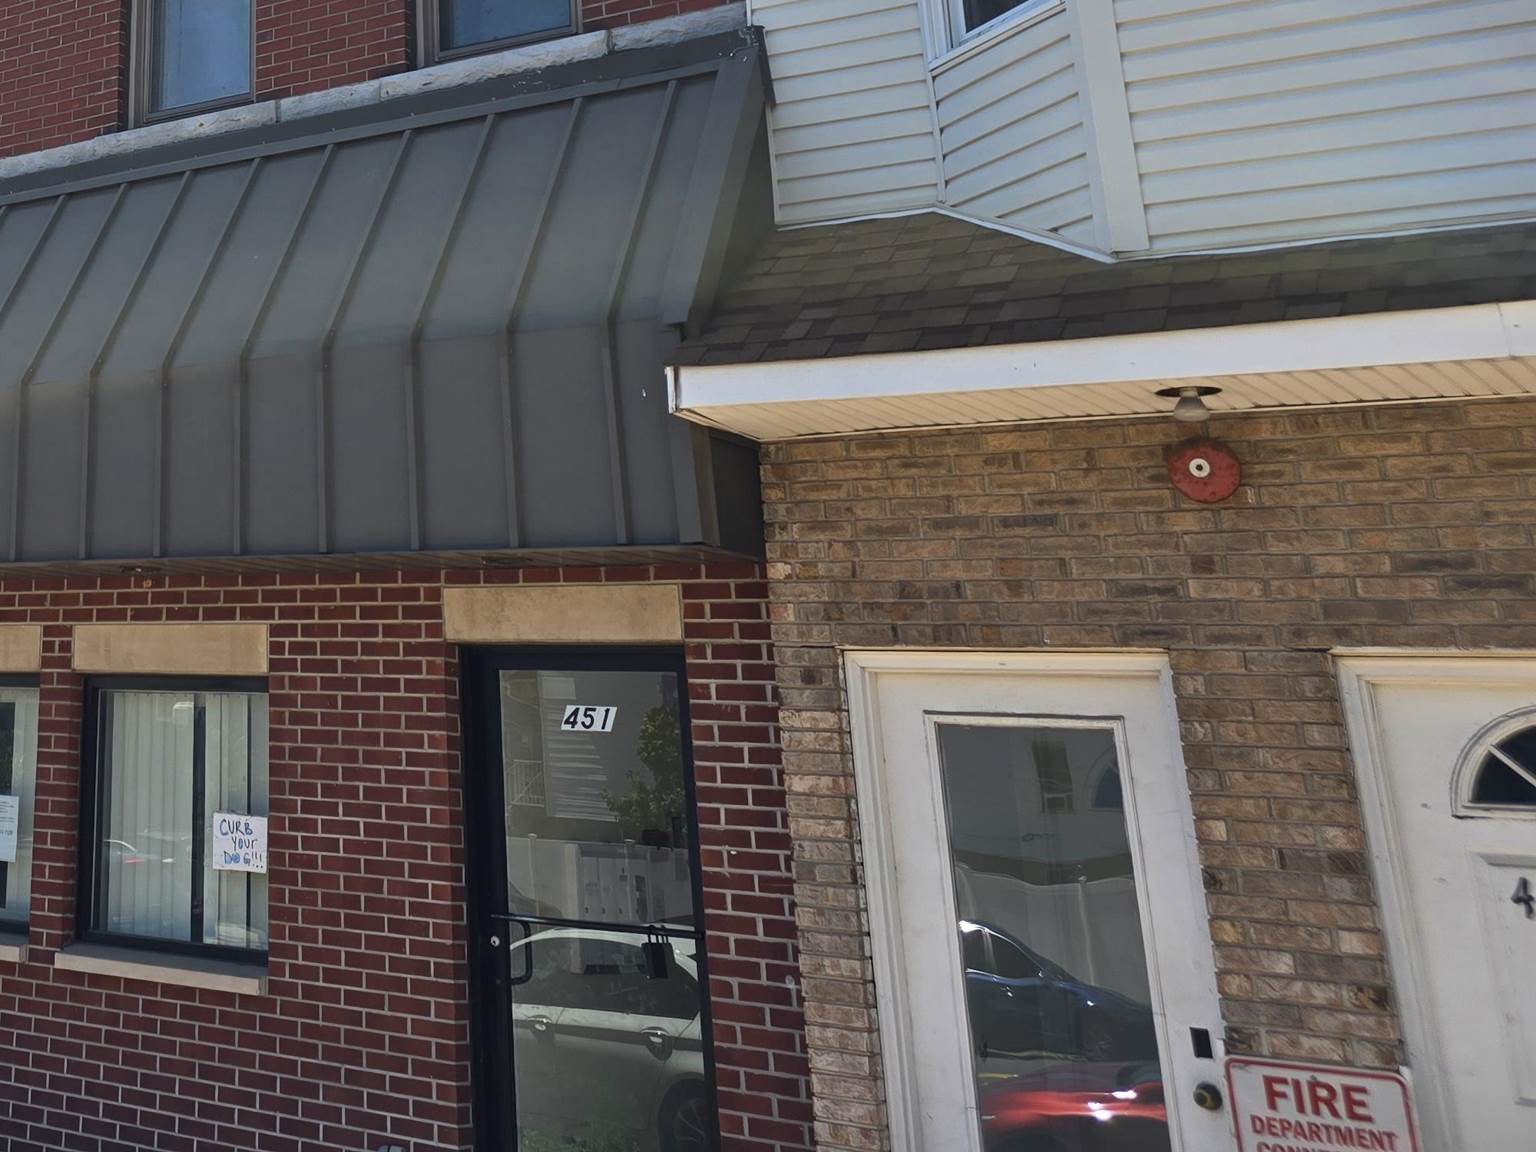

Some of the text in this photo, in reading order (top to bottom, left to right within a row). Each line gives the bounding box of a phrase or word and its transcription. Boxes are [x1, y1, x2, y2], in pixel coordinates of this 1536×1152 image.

[564, 707, 611, 730] 451
[219, 818, 253, 836] CURB
[1262, 1073, 1376, 1124] FIRE
[1250, 1113, 1398, 1151] DEPARTMENT
